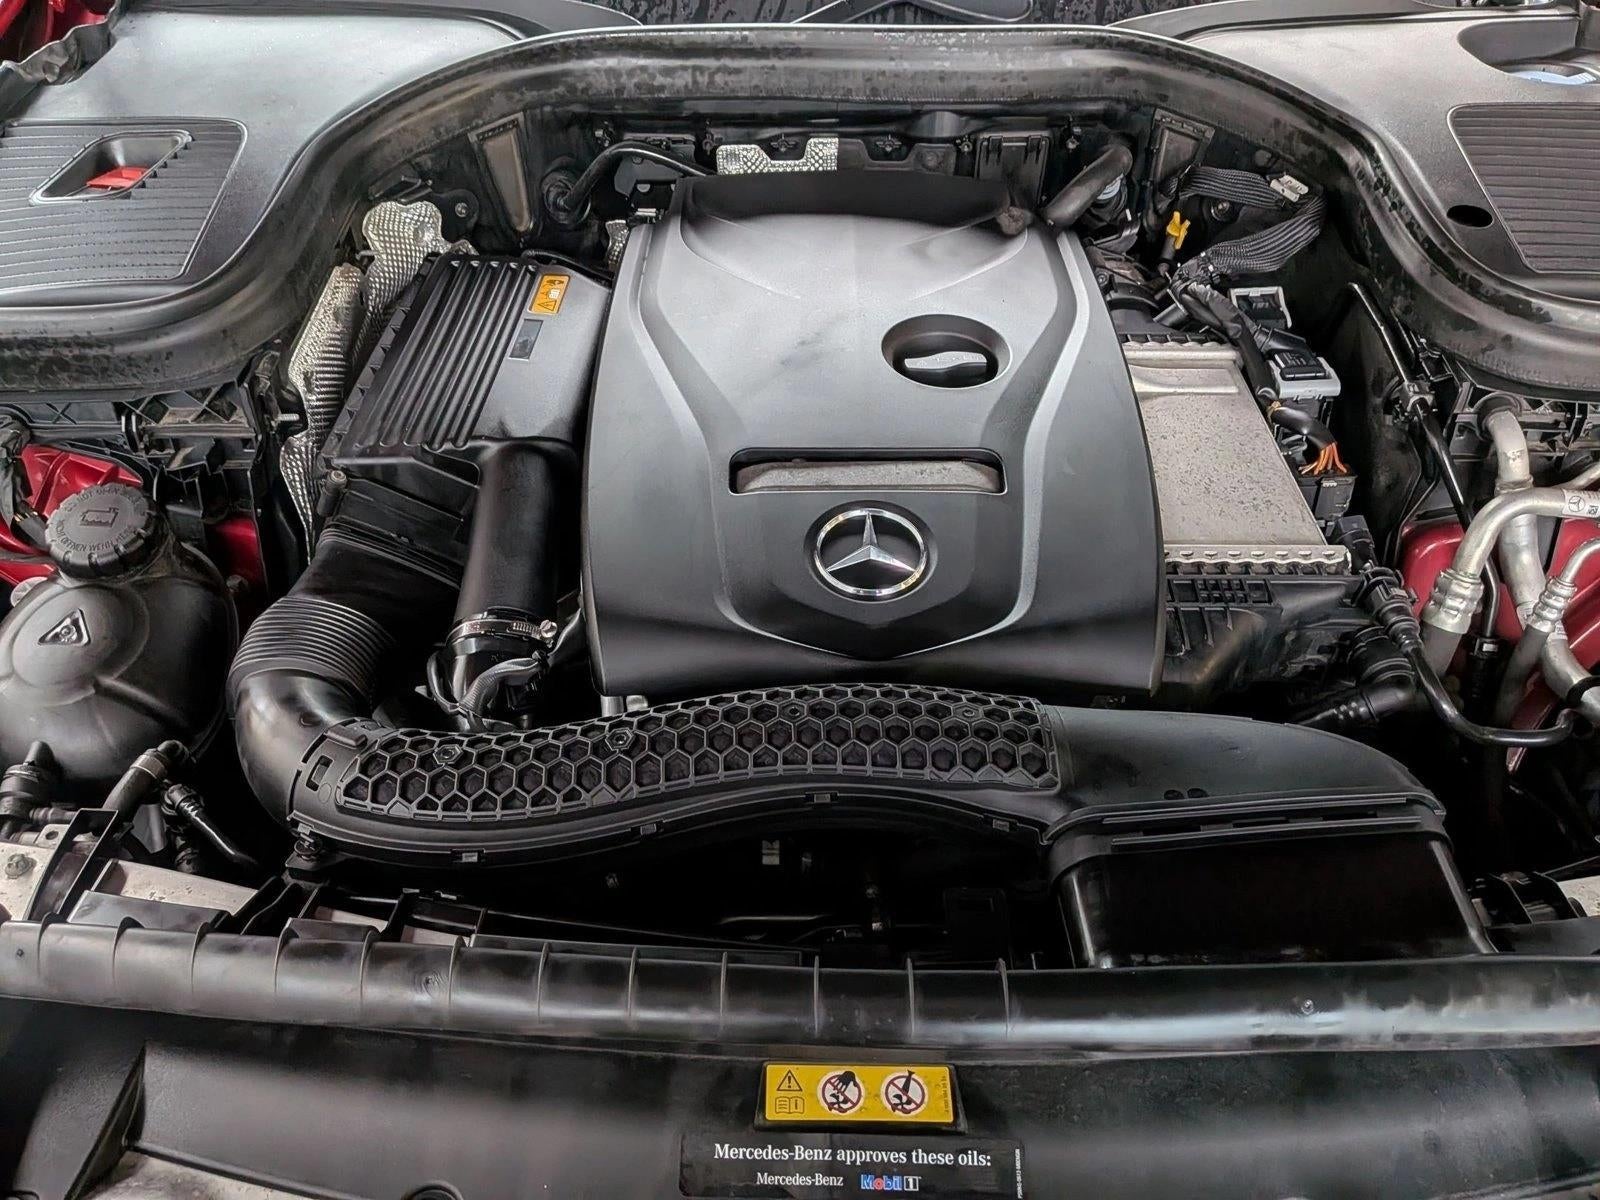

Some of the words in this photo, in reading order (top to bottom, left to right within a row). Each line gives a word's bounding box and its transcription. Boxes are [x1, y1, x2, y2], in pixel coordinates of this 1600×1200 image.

[714, 1143, 832, 1161] Mercedes-Benz
[836, 1149, 907, 1165] approves
[911, 1148, 954, 1165] these
[958, 1150, 992, 1166] oils:
[756, 1172, 844, 1187] Mercedes-Benz
[860, 1174, 903, 1191] Mobil
